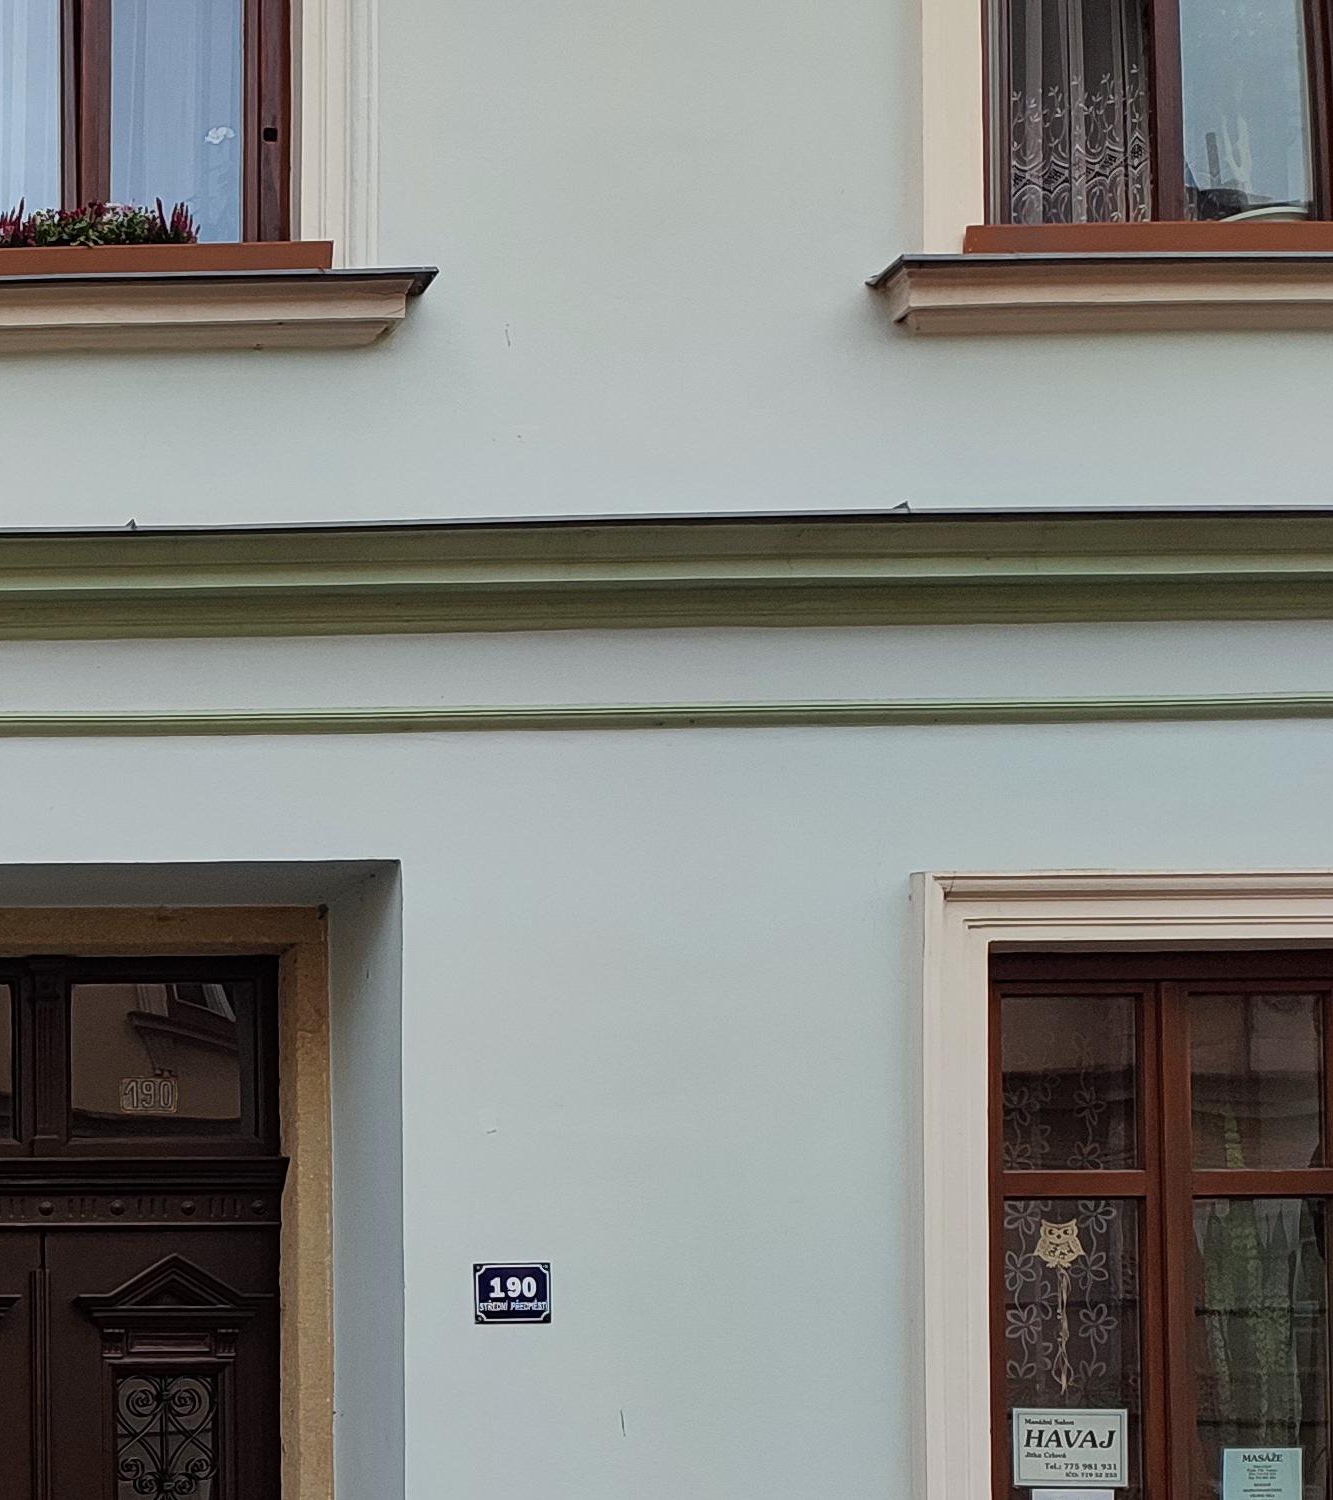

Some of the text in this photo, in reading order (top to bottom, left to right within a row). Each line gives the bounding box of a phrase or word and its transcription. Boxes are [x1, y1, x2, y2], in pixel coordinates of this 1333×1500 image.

[124, 1080, 172, 1108] 190
[489, 1276, 537, 1298] 190
[1024, 1429, 1116, 1449] HAVAJ
[1242, 1453, 1283, 1462] MASÁŽE
